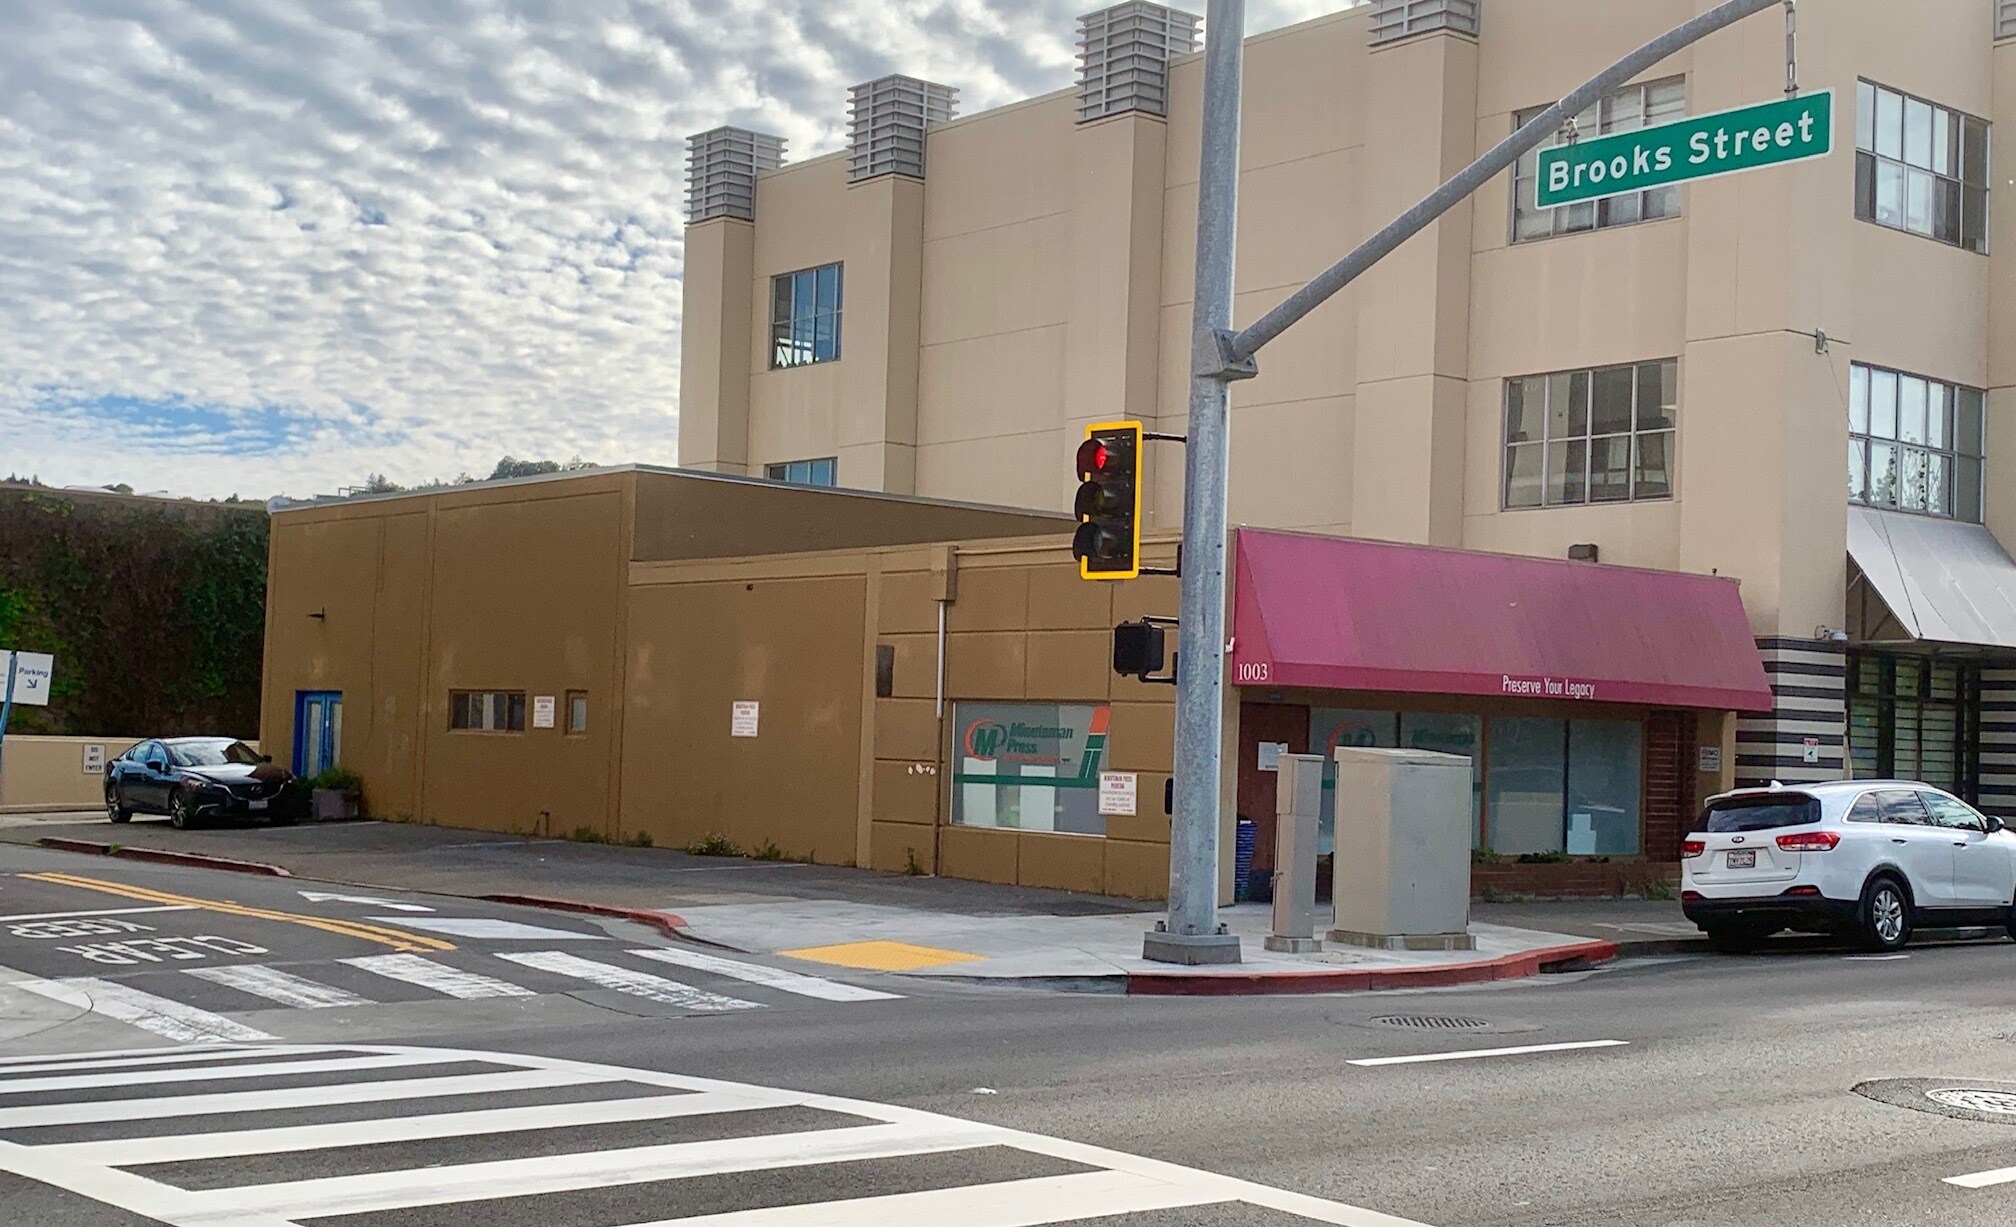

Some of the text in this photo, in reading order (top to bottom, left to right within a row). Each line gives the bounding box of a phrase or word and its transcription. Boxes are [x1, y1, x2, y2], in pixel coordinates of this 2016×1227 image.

[1549, 110, 1814, 192] Brooks Street
[19, 667, 49, 678] Parking
[1238, 663, 1268, 681] 1003
[1502, 675, 1595, 699] Preserve Your Legacy
[1009, 722, 1074, 739] Minuteman
[1007, 739, 1037, 753] Press
[6, 919, 156, 938] KEEP
[55, 935, 269, 965] CLEAR
